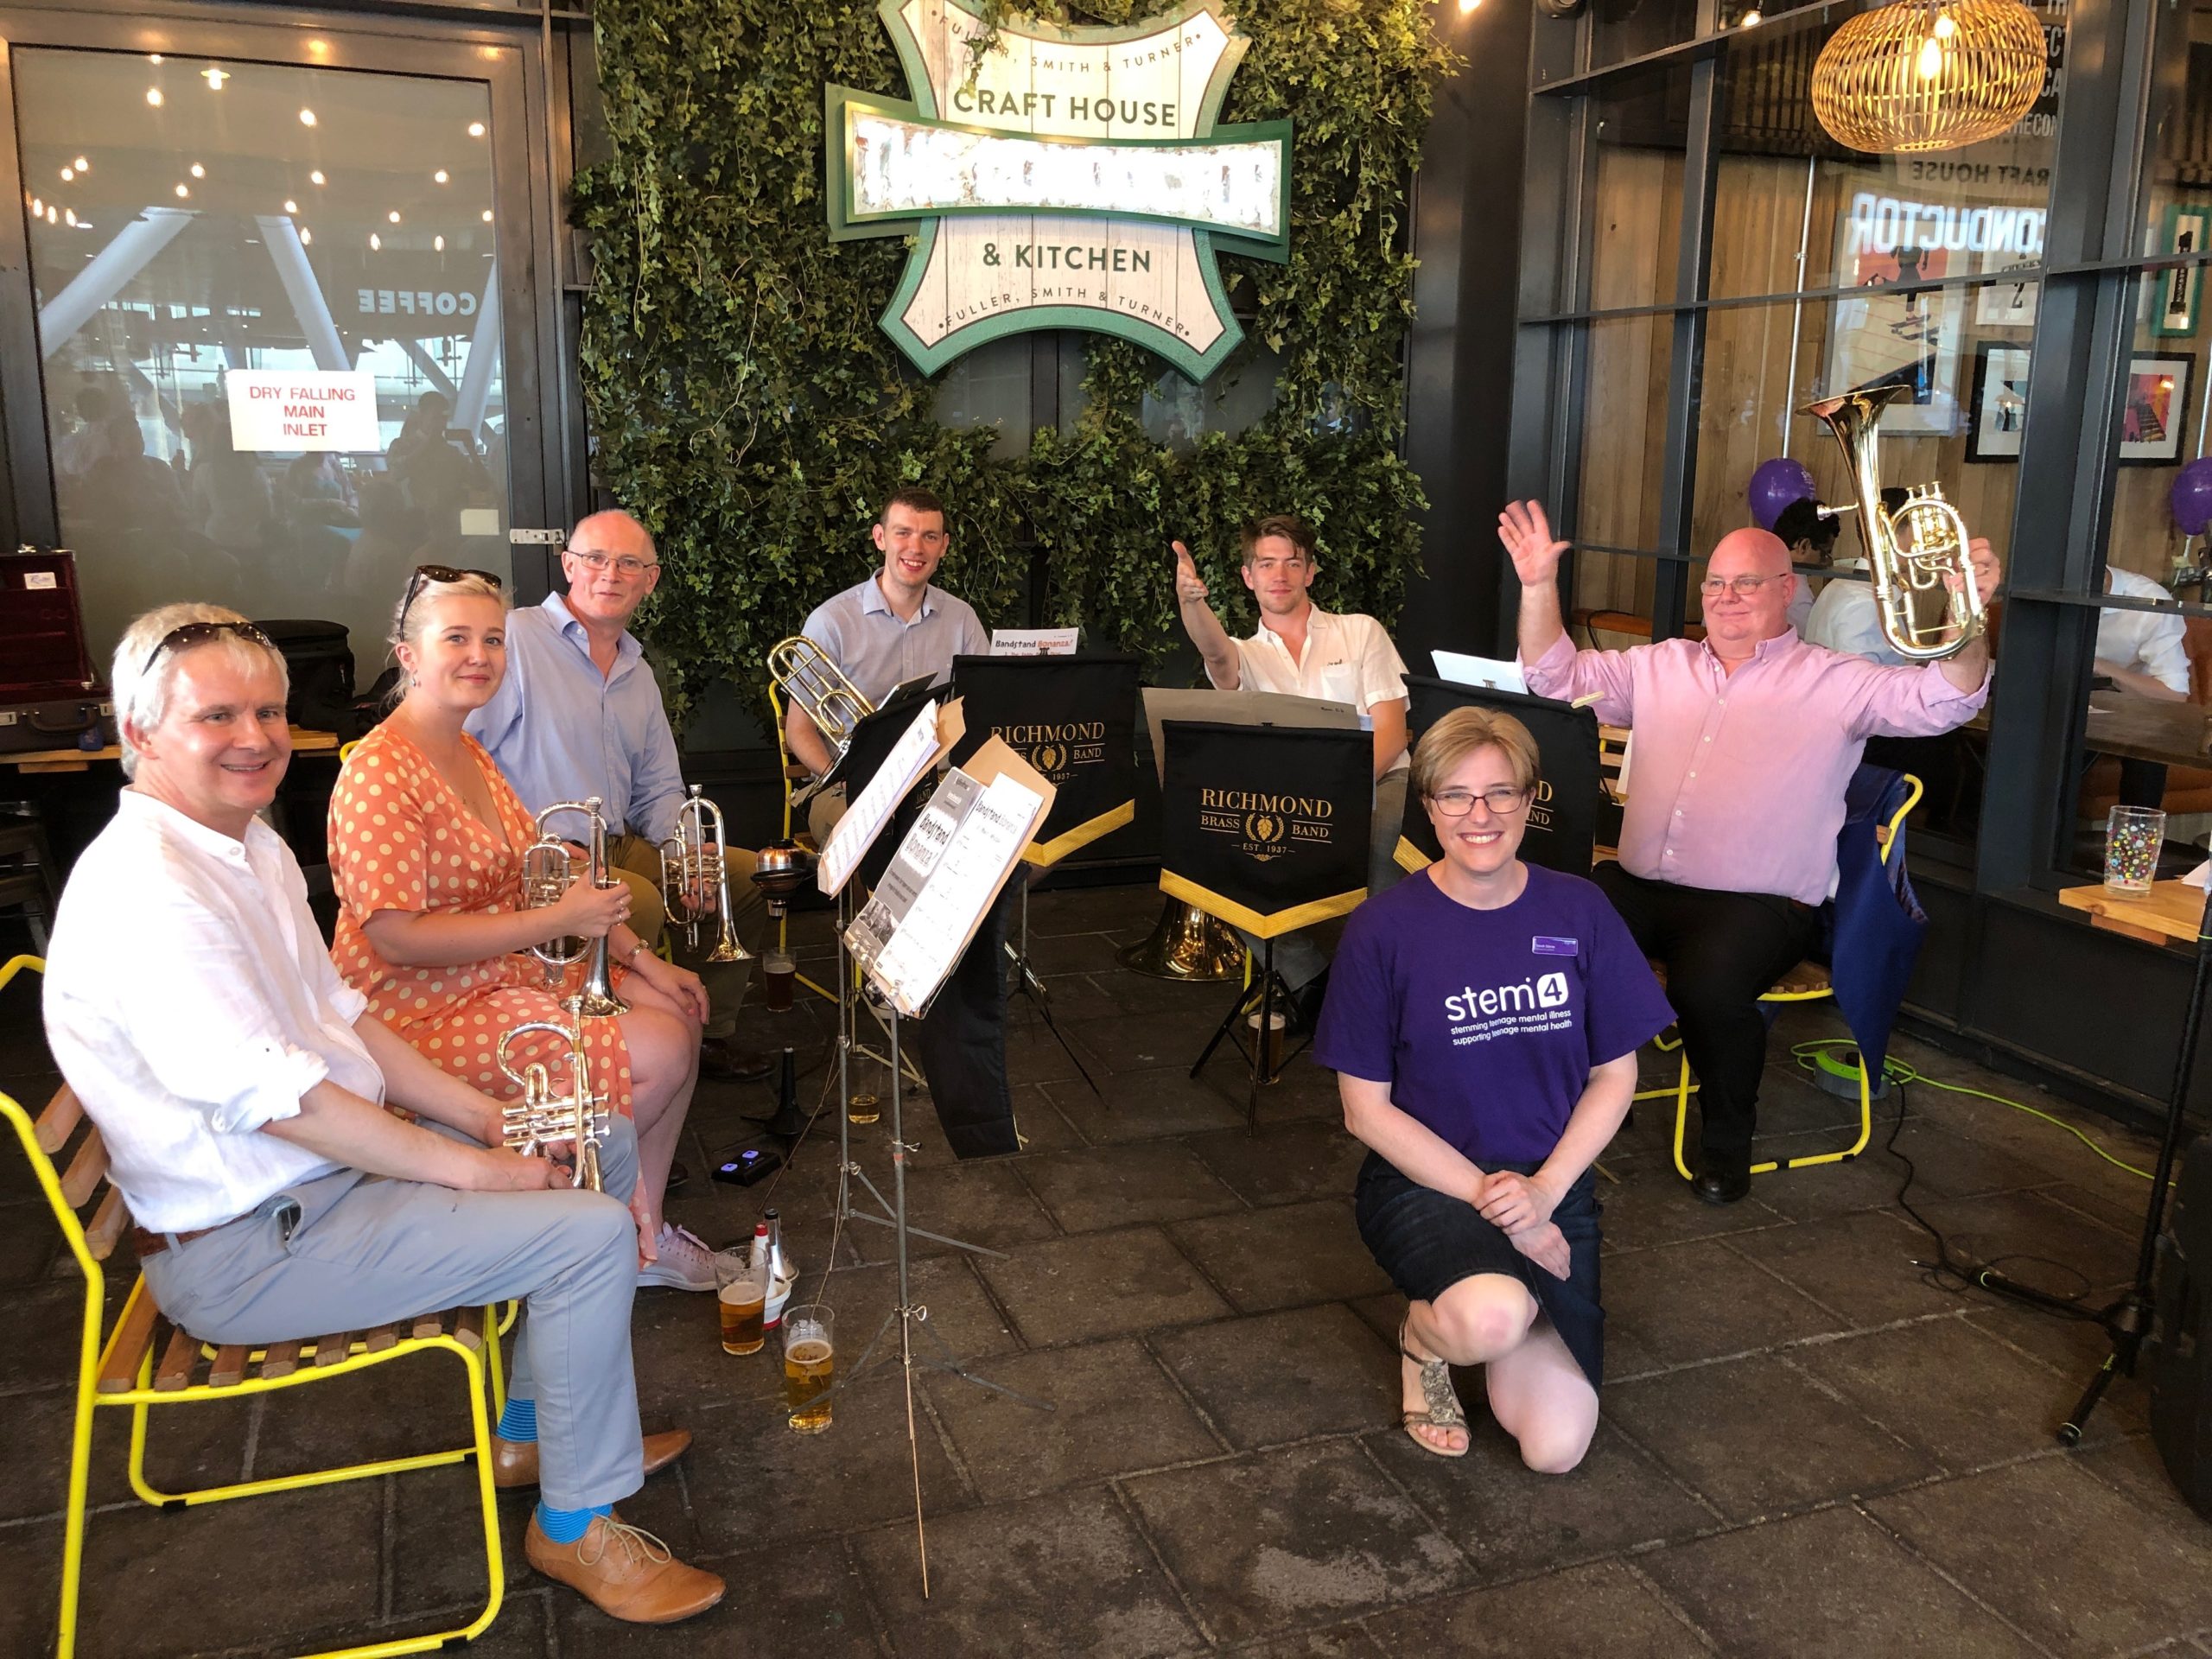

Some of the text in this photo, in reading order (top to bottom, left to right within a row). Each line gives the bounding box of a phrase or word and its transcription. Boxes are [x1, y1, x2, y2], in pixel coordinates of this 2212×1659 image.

[1031, 56, 1090, 73] SMITH
[1103, 61, 1111, 72] &
[1122, 36, 1194, 70] TURNER
[953, 89, 1176, 127] CRAFT HOUSE
[982, 242, 1150, 273] & KITCHEN
[945, 287, 1185, 333] FULLER, SMITH & TURNER
[249, 386, 355, 401] DRY FALLING
[283, 404, 325, 418] MAIN
[283, 423, 327, 436] INLET
[1073, 747, 1102, 760] BAND
[1201, 788, 1333, 818] RICHMOND
[1201, 815, 1329, 838] BRASS BAND
[1267, 844, 1287, 854] 1937
[1451, 1009, 1572, 1035] stemming teenage mental illness
[1452, 1019, 1573, 1046] supporting teenage mental health
